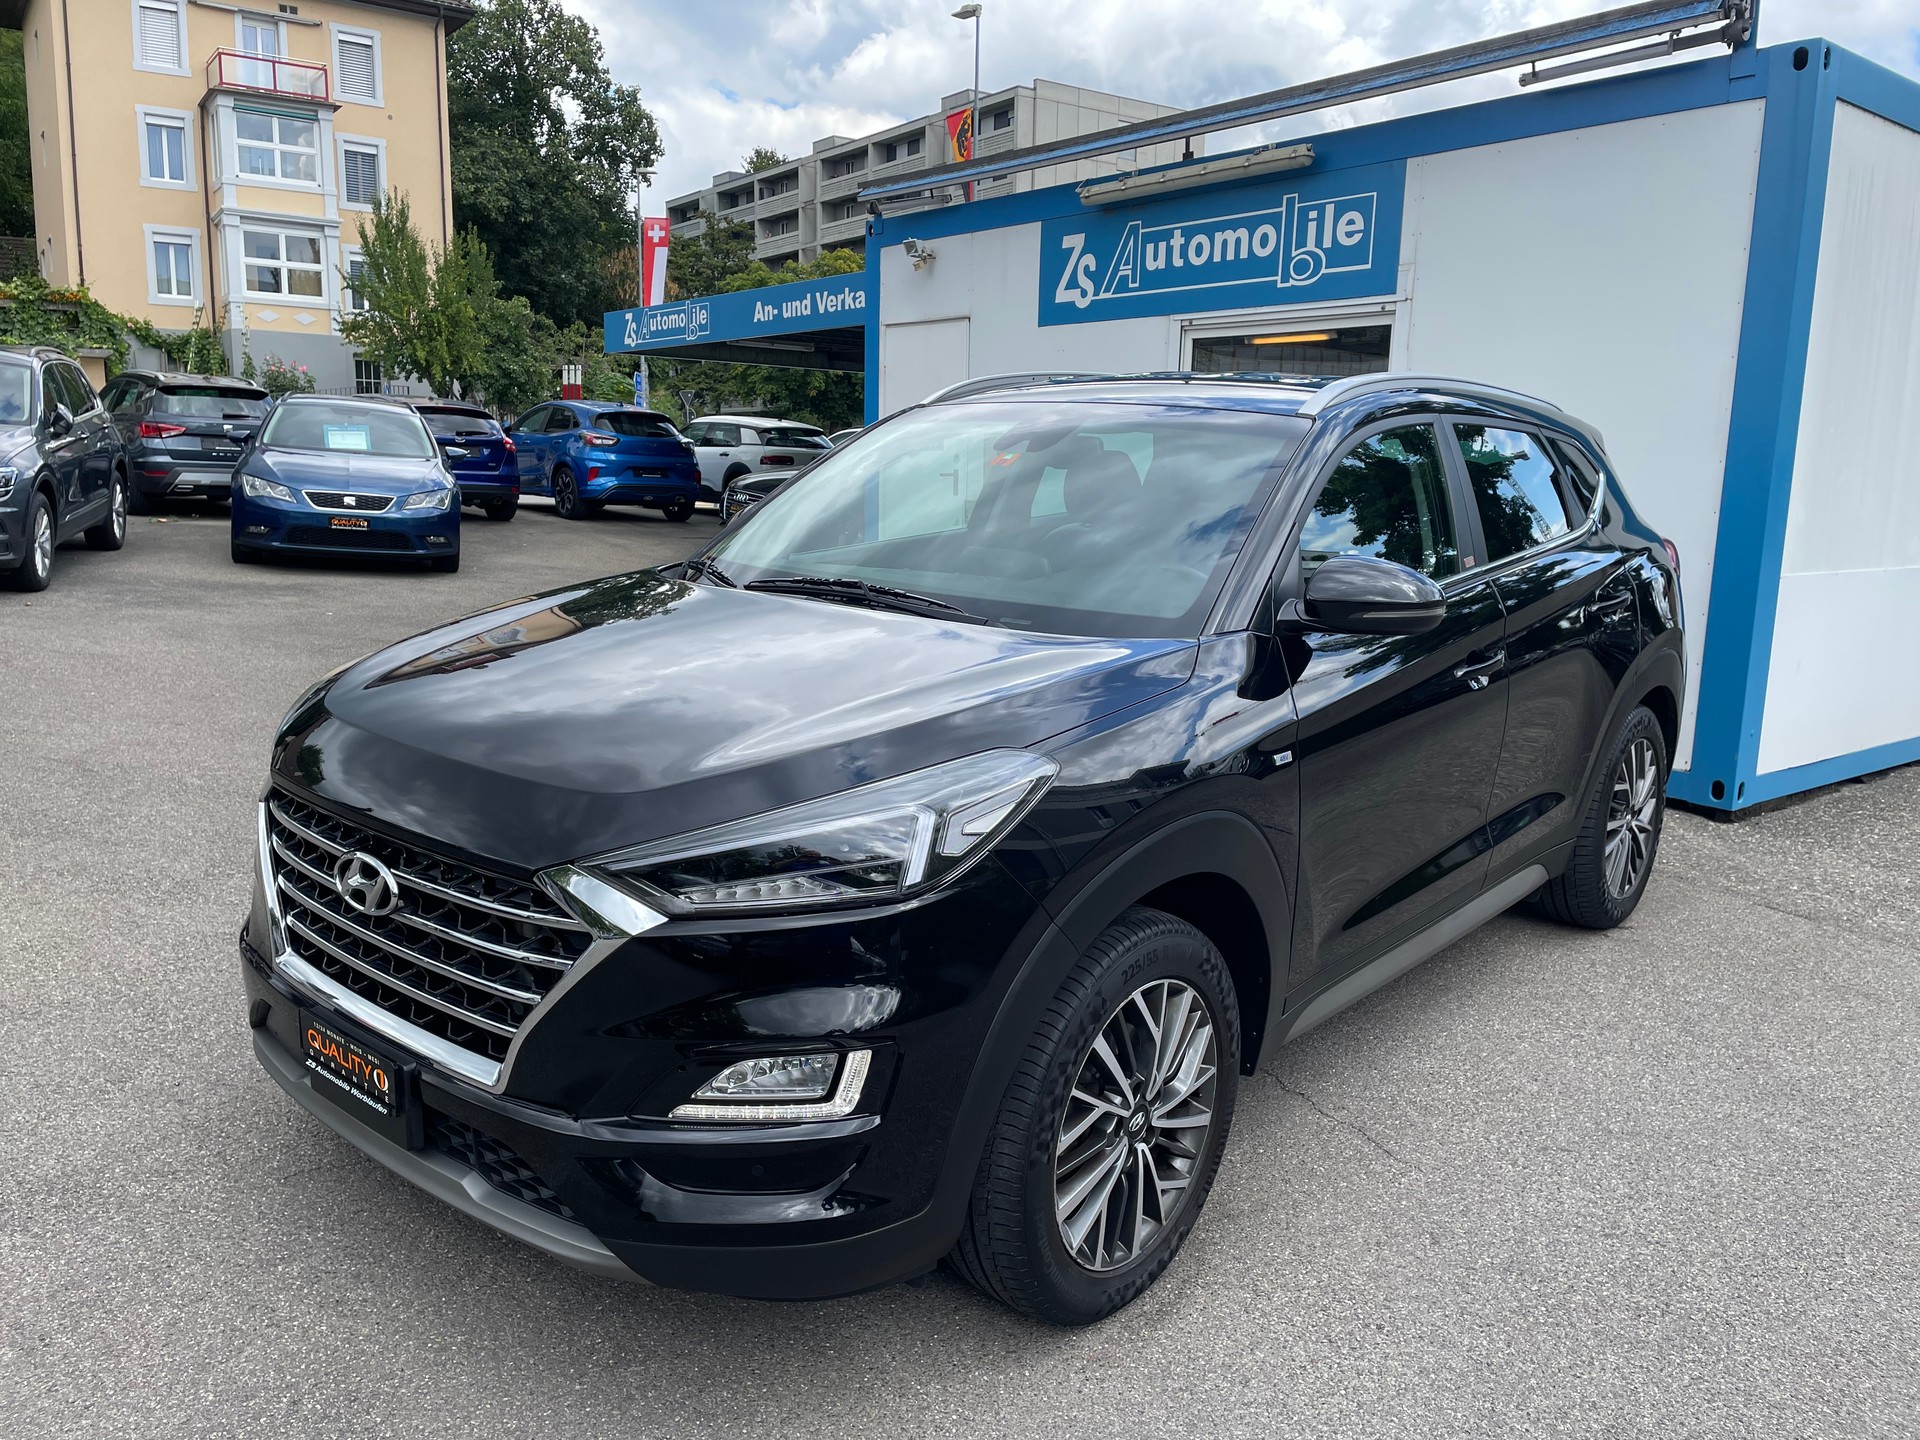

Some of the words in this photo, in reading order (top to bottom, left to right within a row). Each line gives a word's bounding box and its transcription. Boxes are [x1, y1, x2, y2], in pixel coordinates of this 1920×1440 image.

[1100, 193, 1366, 296] Automobile
[638, 301, 707, 342] Automobile
[753, 301, 778, 323] An-
[783, 293, 811, 319] und
[1121, 948, 1159, 987] 225/55
[326, 1028, 345, 1045] MONATE
[350, 1043, 363, 1056] MOIS
[305, 1058, 317, 1069] ZS
[315, 1064, 351, 1091] Automobile
[350, 1086, 388, 1115] Worblaufen
